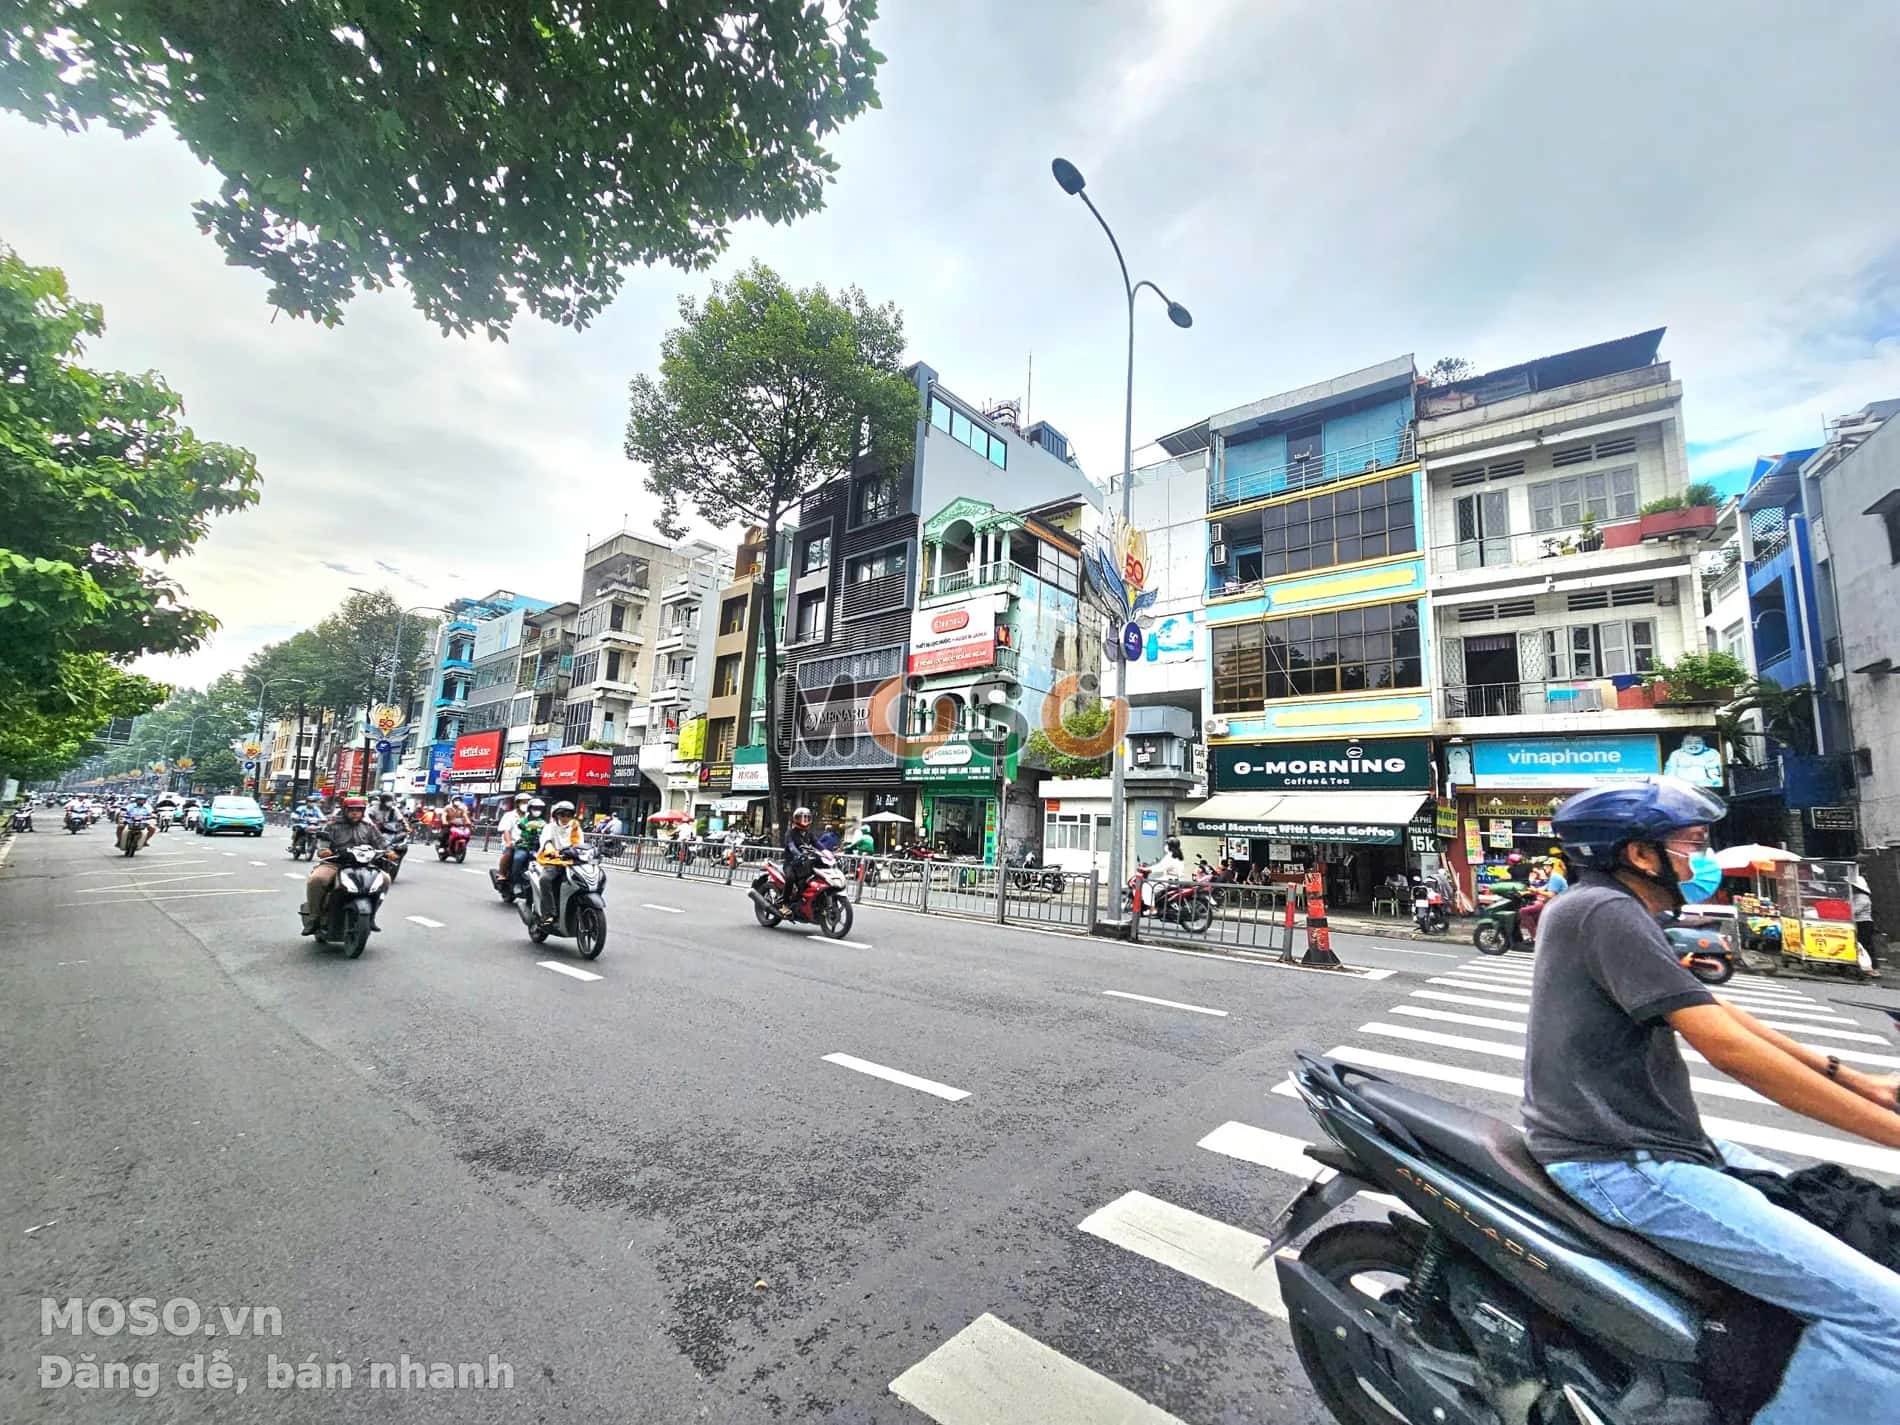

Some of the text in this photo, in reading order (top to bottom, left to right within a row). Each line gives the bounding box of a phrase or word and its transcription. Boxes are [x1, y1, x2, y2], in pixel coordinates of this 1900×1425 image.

[1124, 552, 1145, 584] 50
[820, 707, 871, 725] MENARD
[1508, 748, 1622, 766] vinaphone
[1233, 758, 1406, 775] G-MORNING
[1284, 777, 1319, 785] Coffee
[1330, 777, 1350, 785] Tea
[1197, 822, 1226, 832] Good
[1228, 823, 1277, 835] Morning
[1279, 824, 1308, 834] With
[1309, 825, 1345, 836] Good
[1411, 836, 1436, 851] 15k
